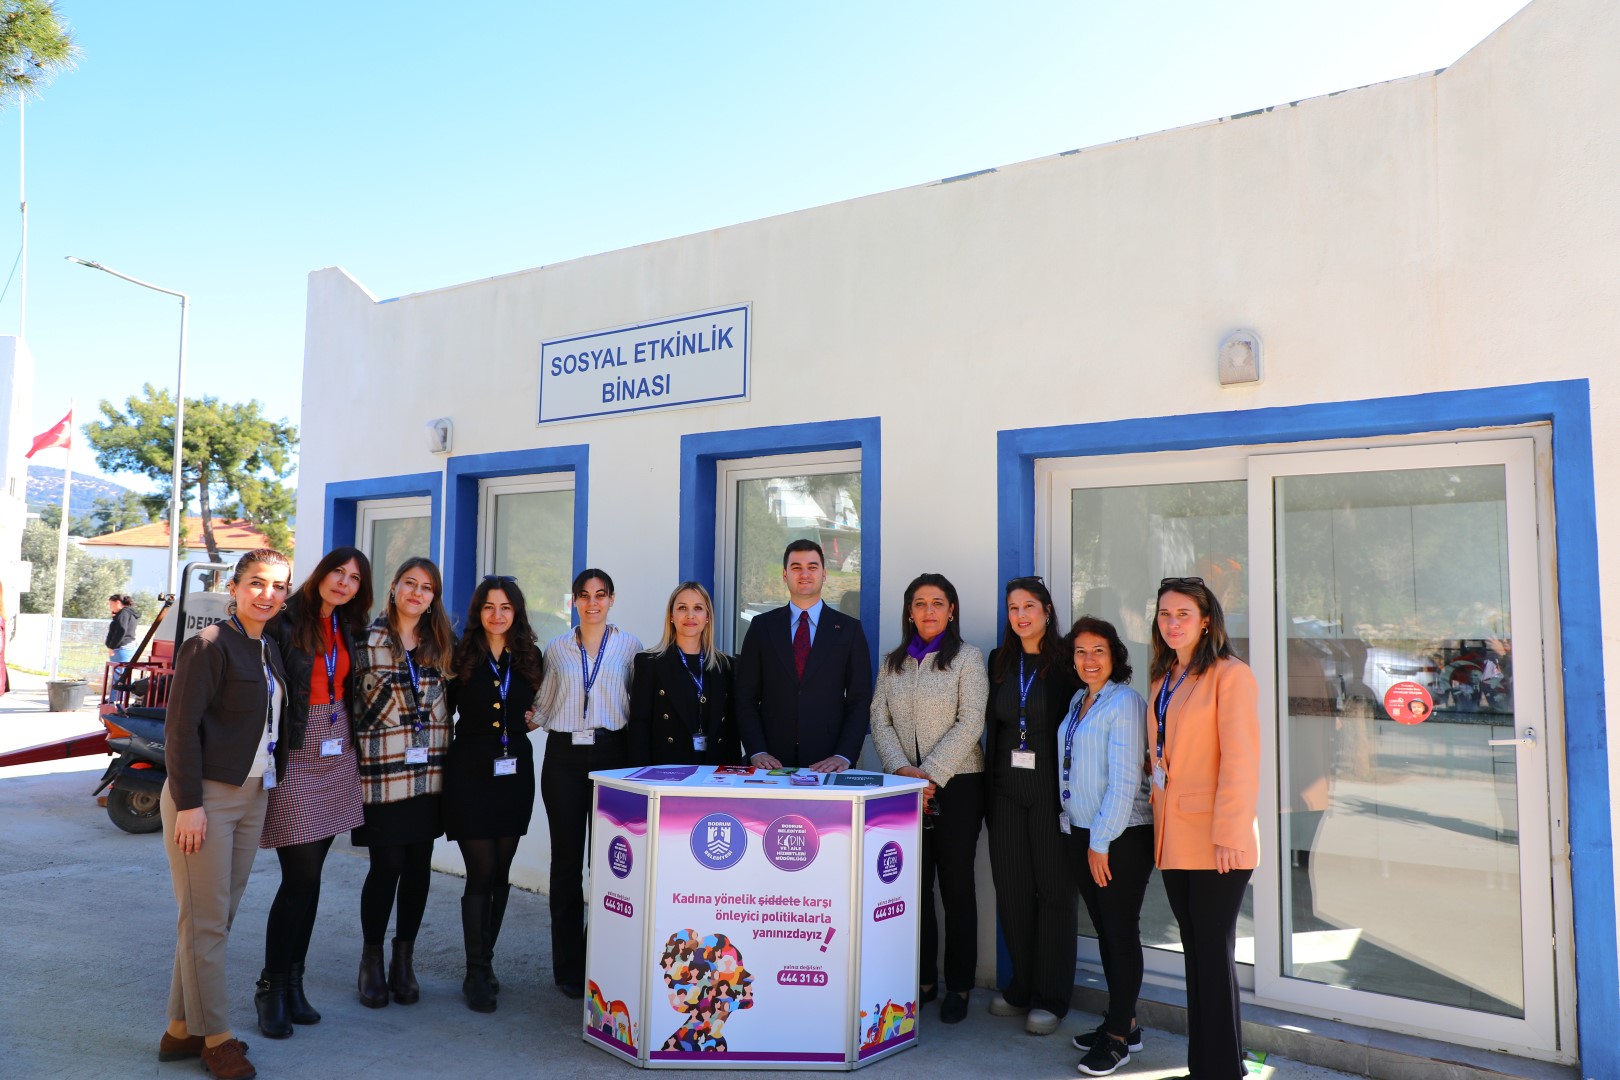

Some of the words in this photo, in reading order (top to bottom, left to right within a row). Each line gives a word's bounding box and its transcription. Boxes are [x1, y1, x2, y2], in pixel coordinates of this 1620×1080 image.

[550, 346, 628, 377] SOSYAL
[634, 324, 734, 364] ETKİNLİK
[602, 373, 671, 404] BİNASI
[605, 899, 616, 909] 444
[616, 902, 623, 912] 31
[672, 893, 712, 904] Kadına
[714, 893, 756, 906] yönelik
[758, 895, 801, 907] şiddete
[803, 896, 832, 909] karşı
[715, 909, 759, 923] önleyici
[761, 911, 832, 924] politikalarla
[875, 909, 887, 919] 444
[887, 906, 895, 916] 31
[896, 903, 904, 913] 63
[780, 973, 798, 983] 444
[799, 973, 811, 983] 31
[813, 974, 825, 984] 63
